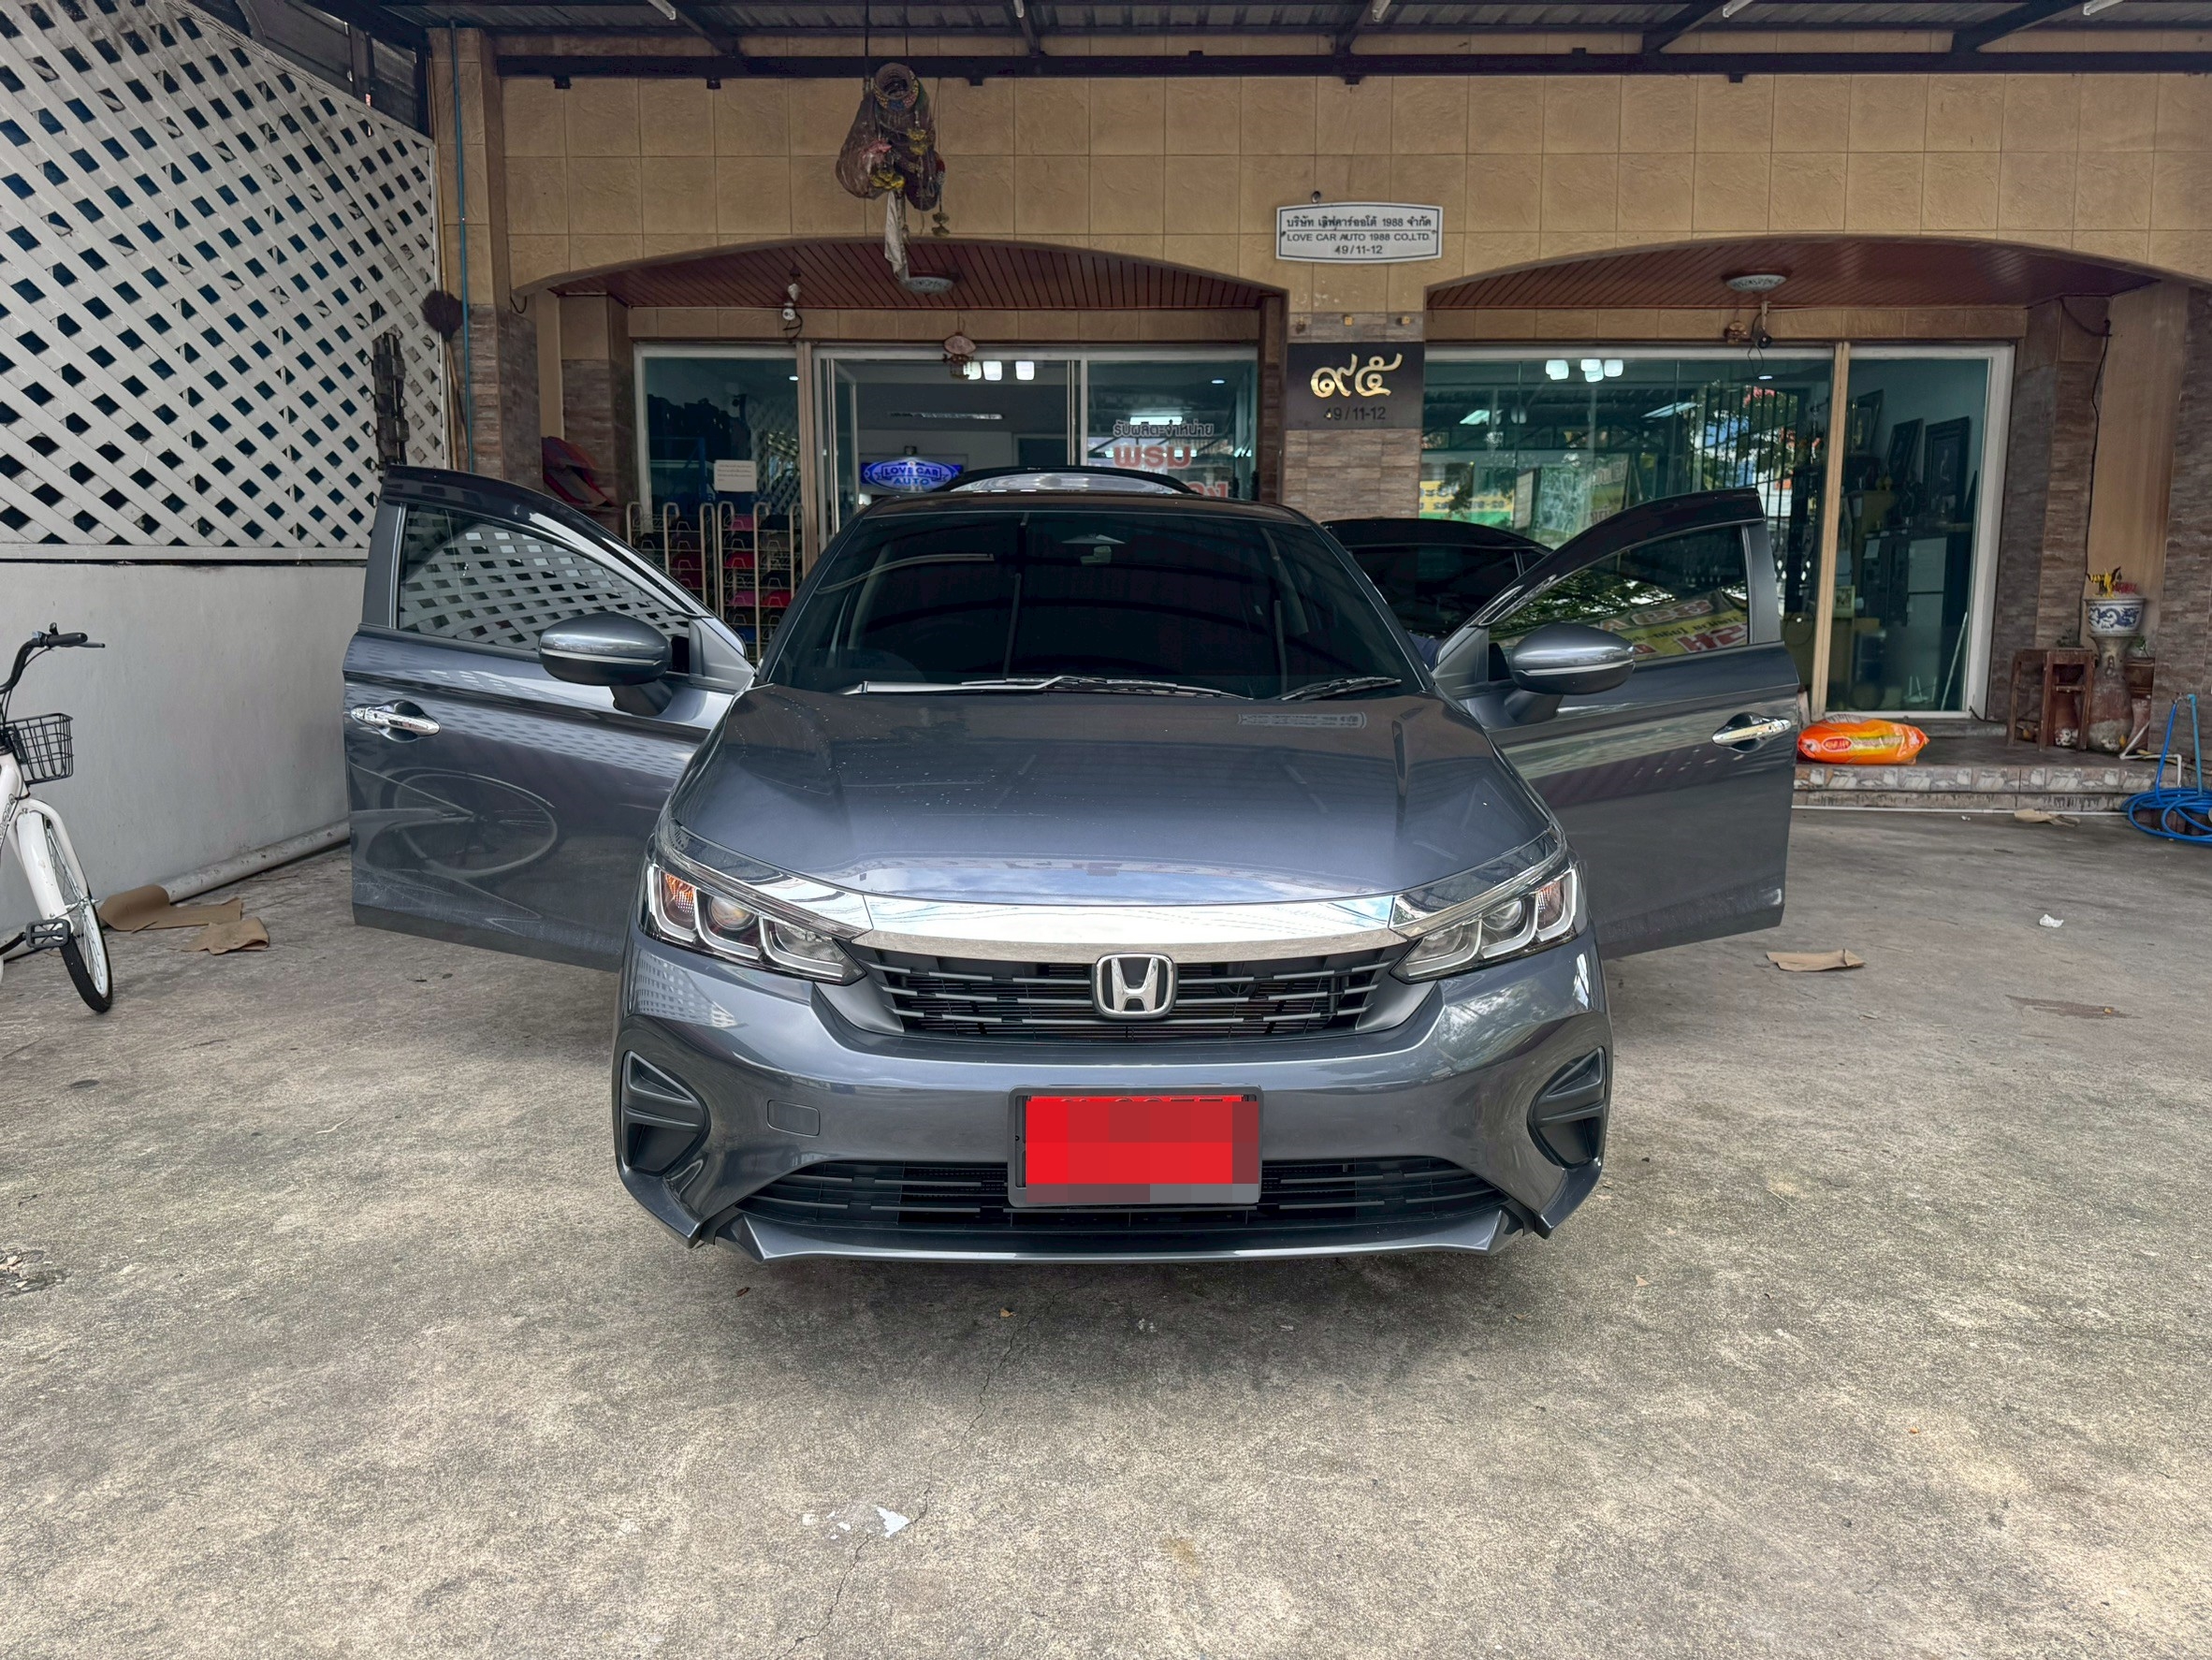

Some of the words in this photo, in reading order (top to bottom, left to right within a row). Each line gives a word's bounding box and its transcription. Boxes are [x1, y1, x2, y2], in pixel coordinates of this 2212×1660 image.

[1287, 215, 1315, 227] บริษัท
[1382, 218, 1404, 226] 1988
[1406, 215, 1432, 226] จำกัด
[1287, 233, 1313, 241] LOVE
[1316, 233, 1336, 241] CAR
[1339, 233, 1366, 241] AUTO
[1370, 233, 1390, 241] 1988
[1113, 444, 1193, 469] พรม
[916, 468, 939, 476] CAR
